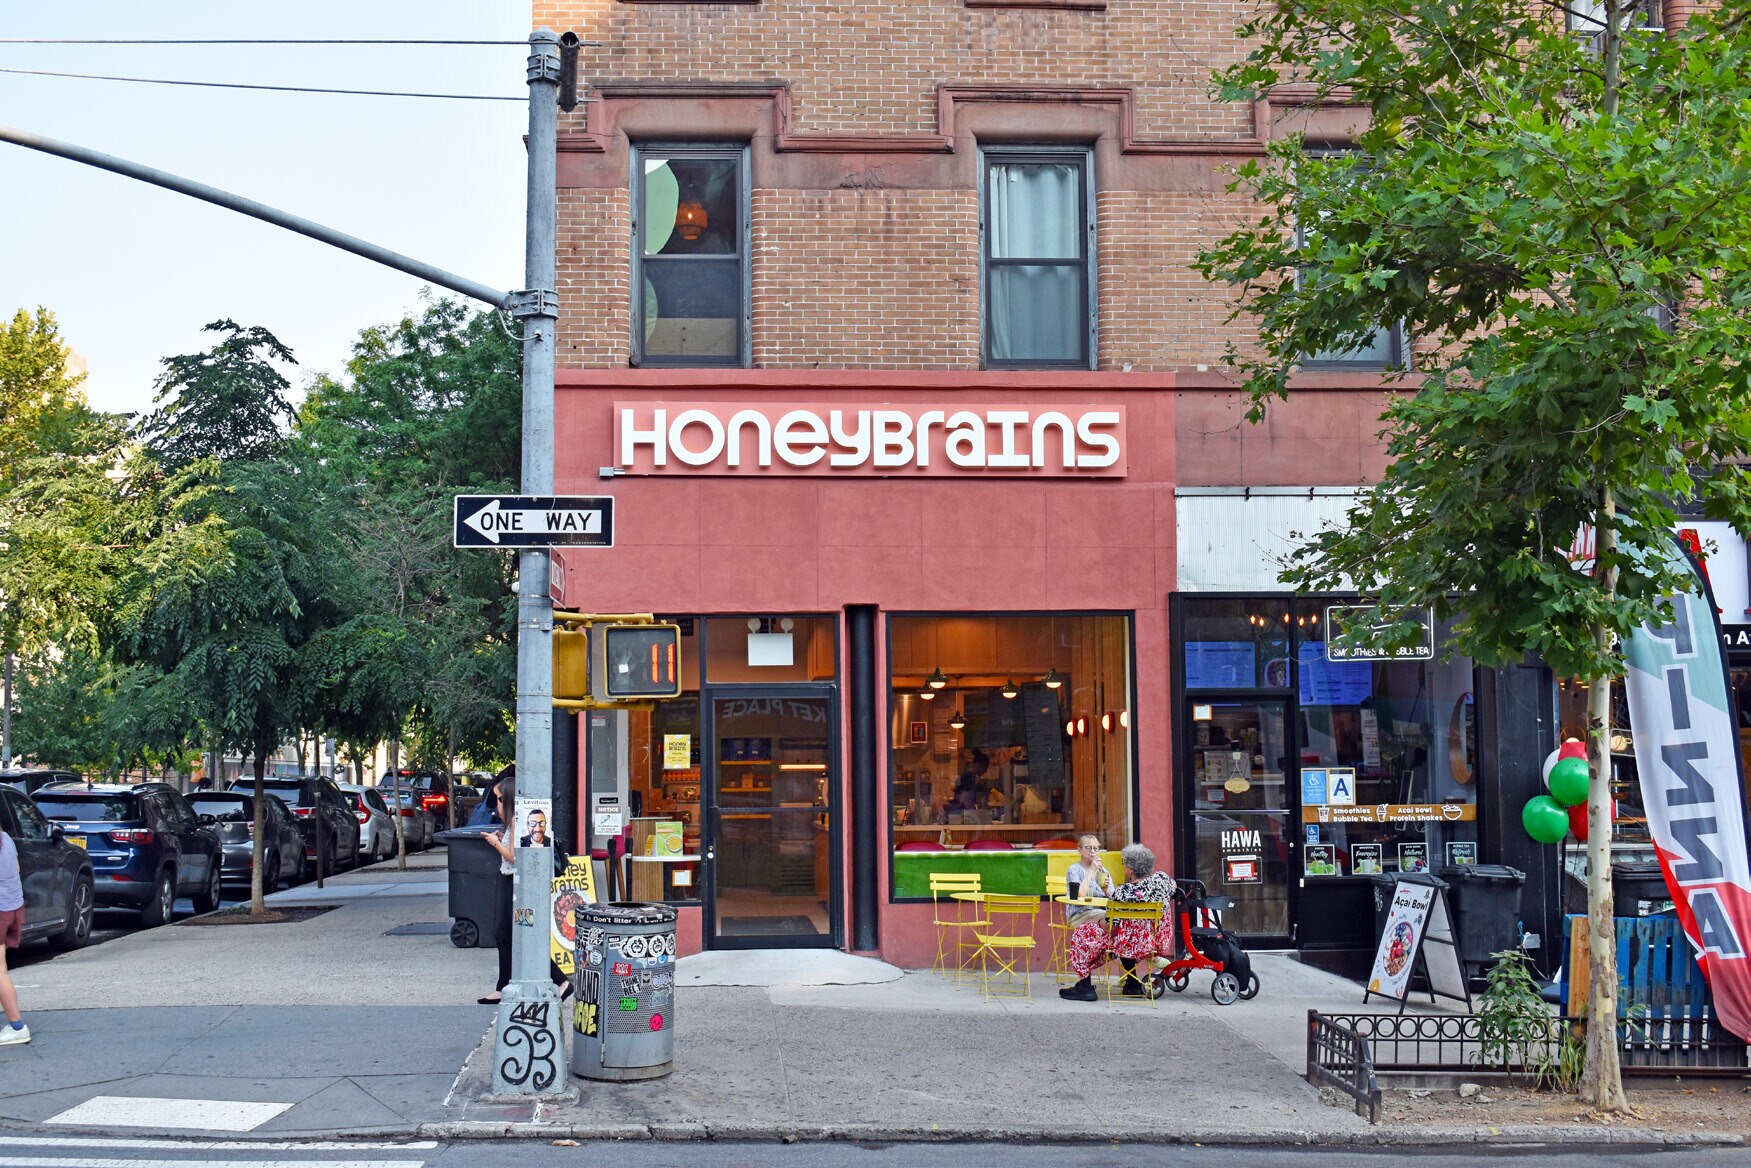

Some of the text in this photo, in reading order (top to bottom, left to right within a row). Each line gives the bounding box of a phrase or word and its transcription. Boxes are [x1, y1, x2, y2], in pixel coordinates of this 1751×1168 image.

[480, 512, 592, 531] ONE WAY
[1415, 646, 1430, 656] TEA
[651, 643, 675, 684] 11
[1333, 777, 1350, 797] A
[1333, 807, 1371, 815] Smoothies
[1221, 830, 1262, 848] HAWA
[1411, 899, 1429, 911] Bowl
[593, 915, 612, 923] Don't
[554, 952, 575, 966] EA
